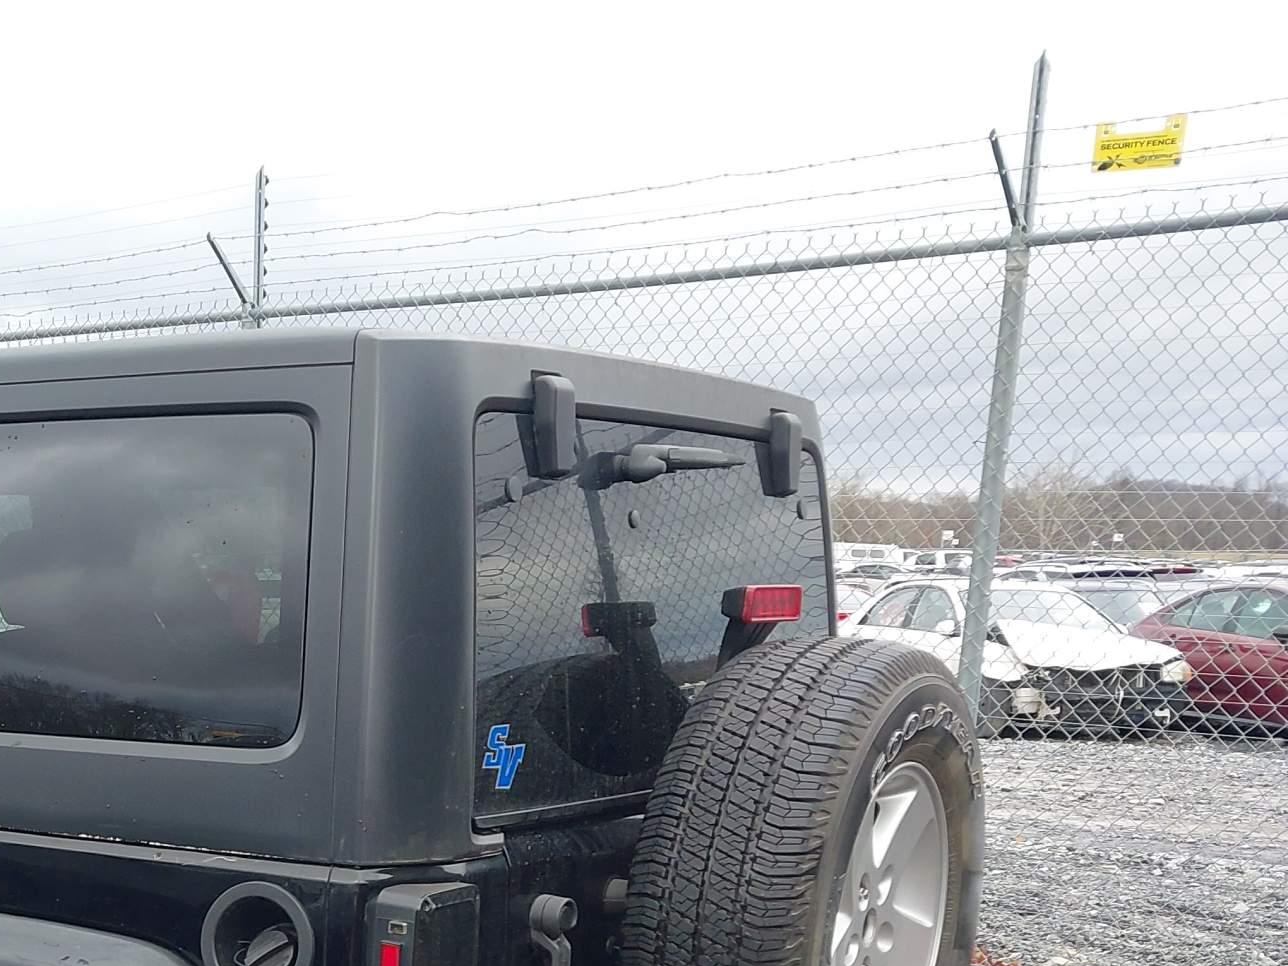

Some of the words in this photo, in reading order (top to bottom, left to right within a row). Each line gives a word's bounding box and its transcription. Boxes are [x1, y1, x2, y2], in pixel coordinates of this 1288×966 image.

[1100, 139, 1146, 151] SECURITY
[1146, 137, 1178, 147] FENCE
[481, 724, 527, 790] SV
